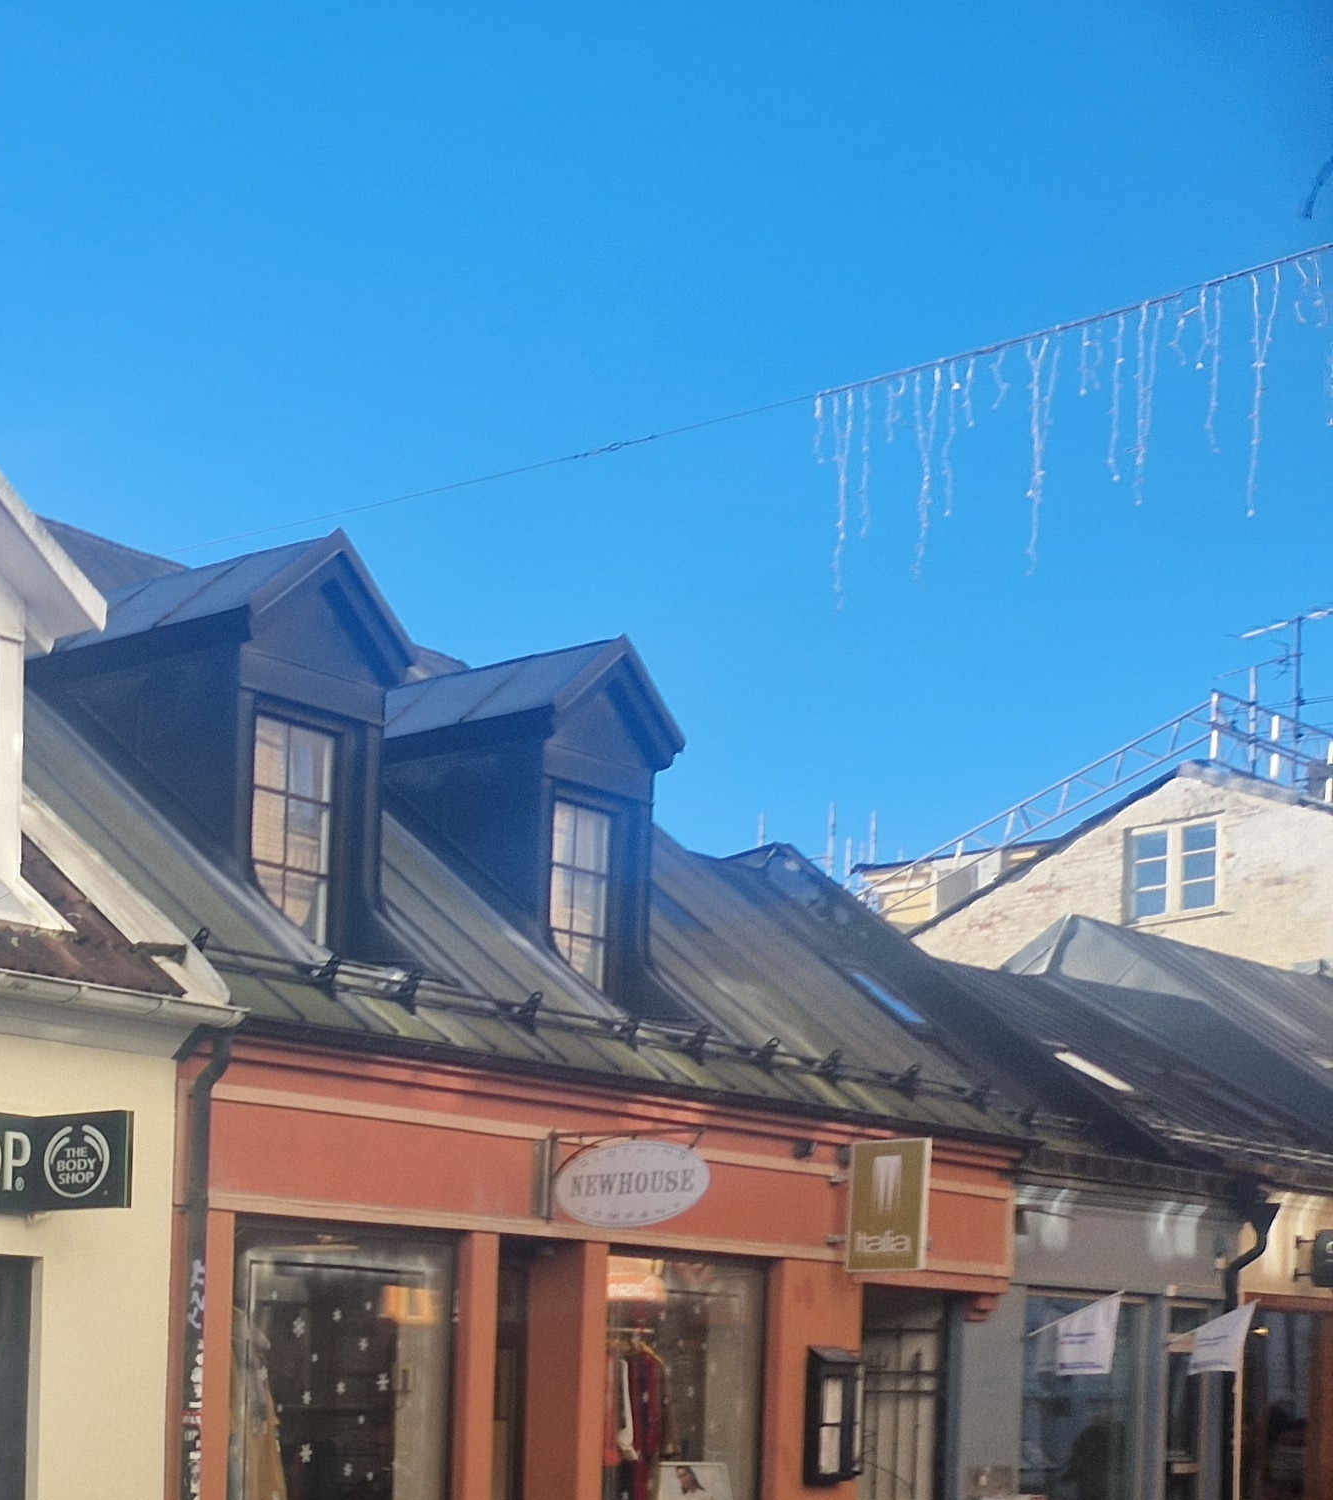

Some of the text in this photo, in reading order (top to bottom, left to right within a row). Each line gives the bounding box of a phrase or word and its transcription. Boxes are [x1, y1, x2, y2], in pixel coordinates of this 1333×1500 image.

[64, 1147, 88, 1158] THE
[56, 1158, 97, 1172] BODY
[58, 1171, 95, 1185] SHOP
[570, 1168, 696, 1198] NEWHOUSE
